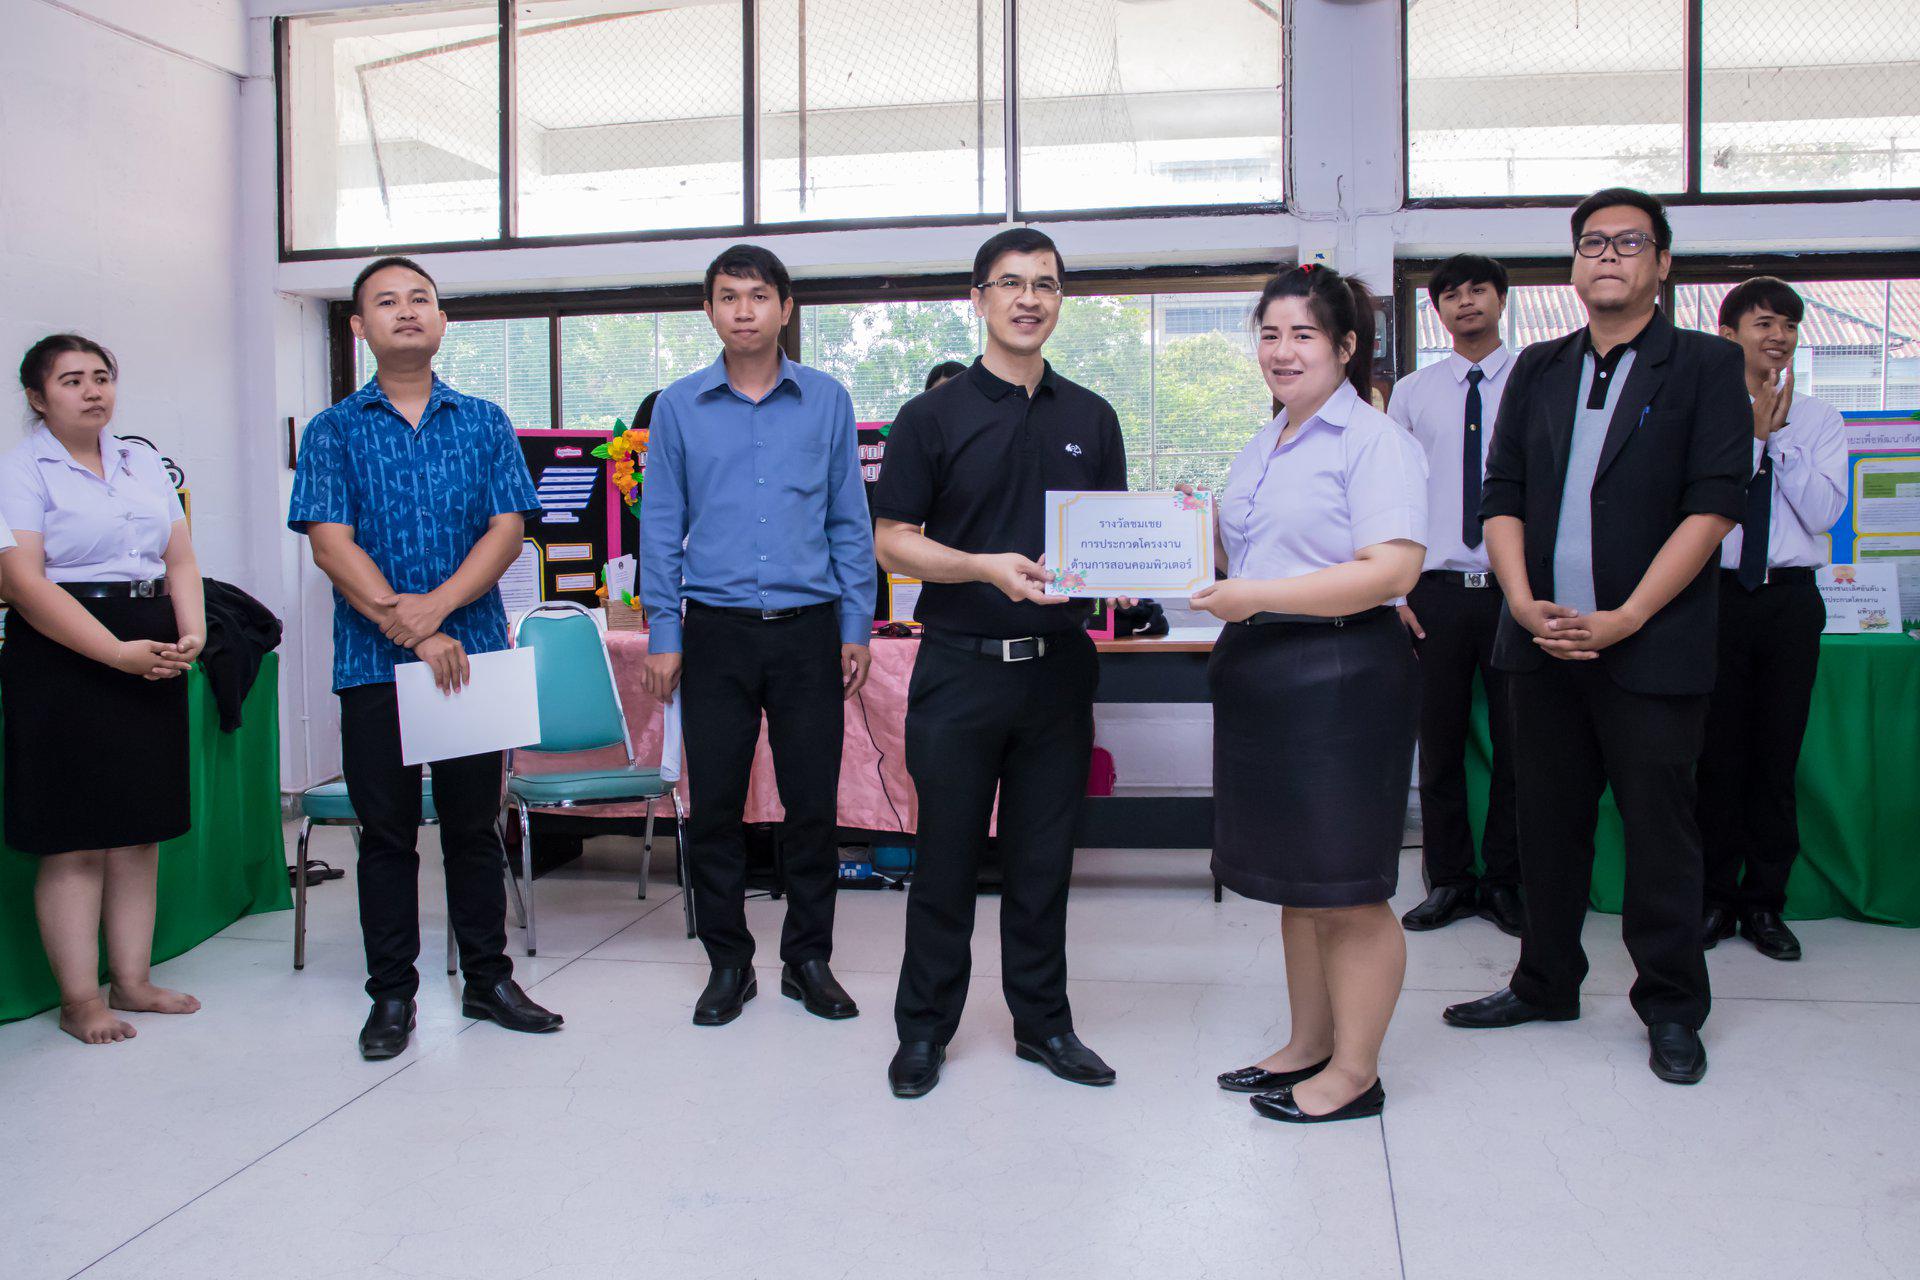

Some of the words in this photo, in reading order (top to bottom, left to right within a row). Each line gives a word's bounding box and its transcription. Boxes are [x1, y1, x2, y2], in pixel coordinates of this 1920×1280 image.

[1099, 517, 1162, 529] รางวัลชมเชย
[1081, 537, 1181, 549] การประกวดโครงงาน
[1071, 558, 1192, 570] ด้านการสอนคอมพิวเตอร์
